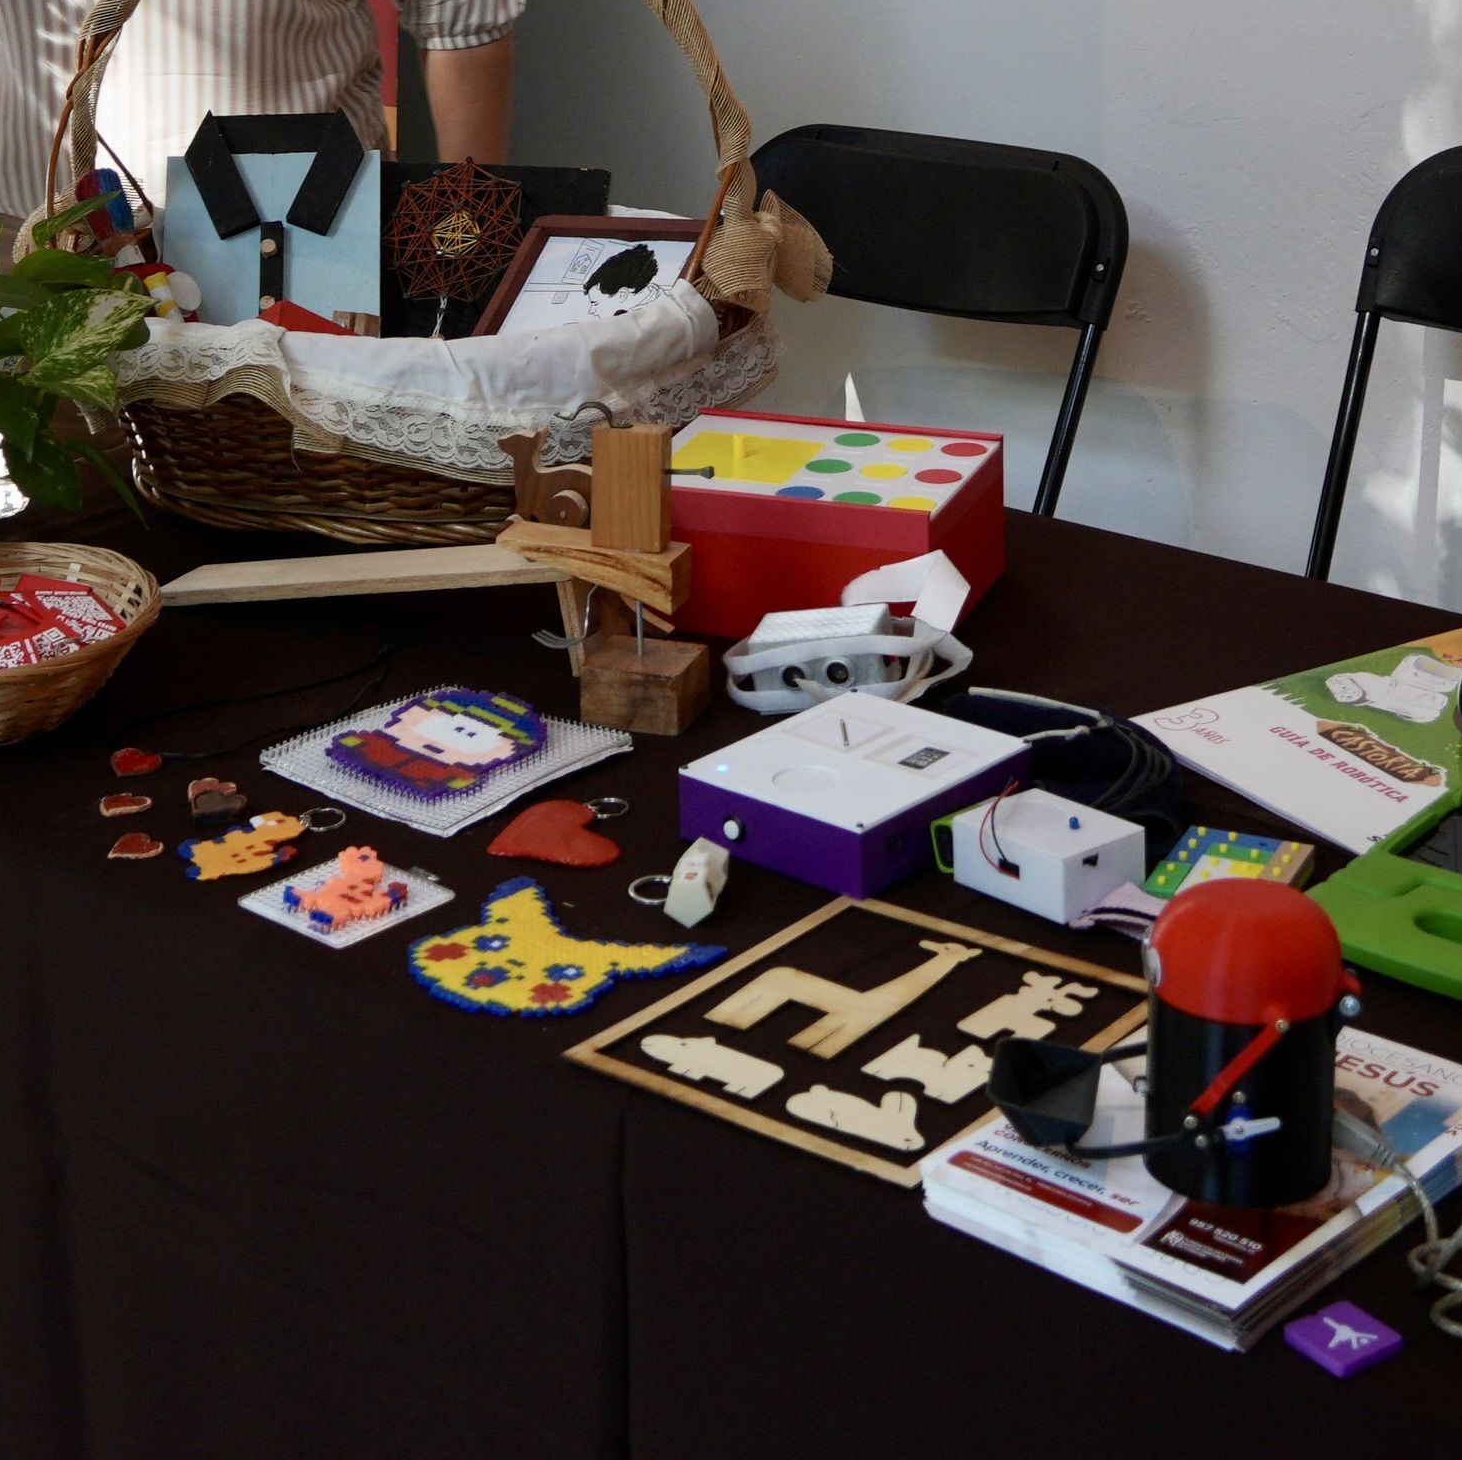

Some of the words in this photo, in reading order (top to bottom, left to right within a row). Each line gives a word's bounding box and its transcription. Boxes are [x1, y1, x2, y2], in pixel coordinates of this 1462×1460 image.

[1154, 707, 1219, 732] 3
[1191, 726, 1232, 745] AÑOS
[1269, 725, 1311, 749] GUÍA
[1308, 747, 1334, 761] DE
[1330, 759, 1410, 804] ROBÓTICA
[1329, 728, 1425, 781] CASTORIA
[974, 1139, 1050, 1174] Aprender,
[1053, 1169, 1108, 1197] crecer,
[1108, 1192, 1141, 1207] ser
[1188, 1217, 1215, 1233] 957
[1214, 1227, 1241, 1242] 520
[1238, 1238, 1264, 1253] 510
